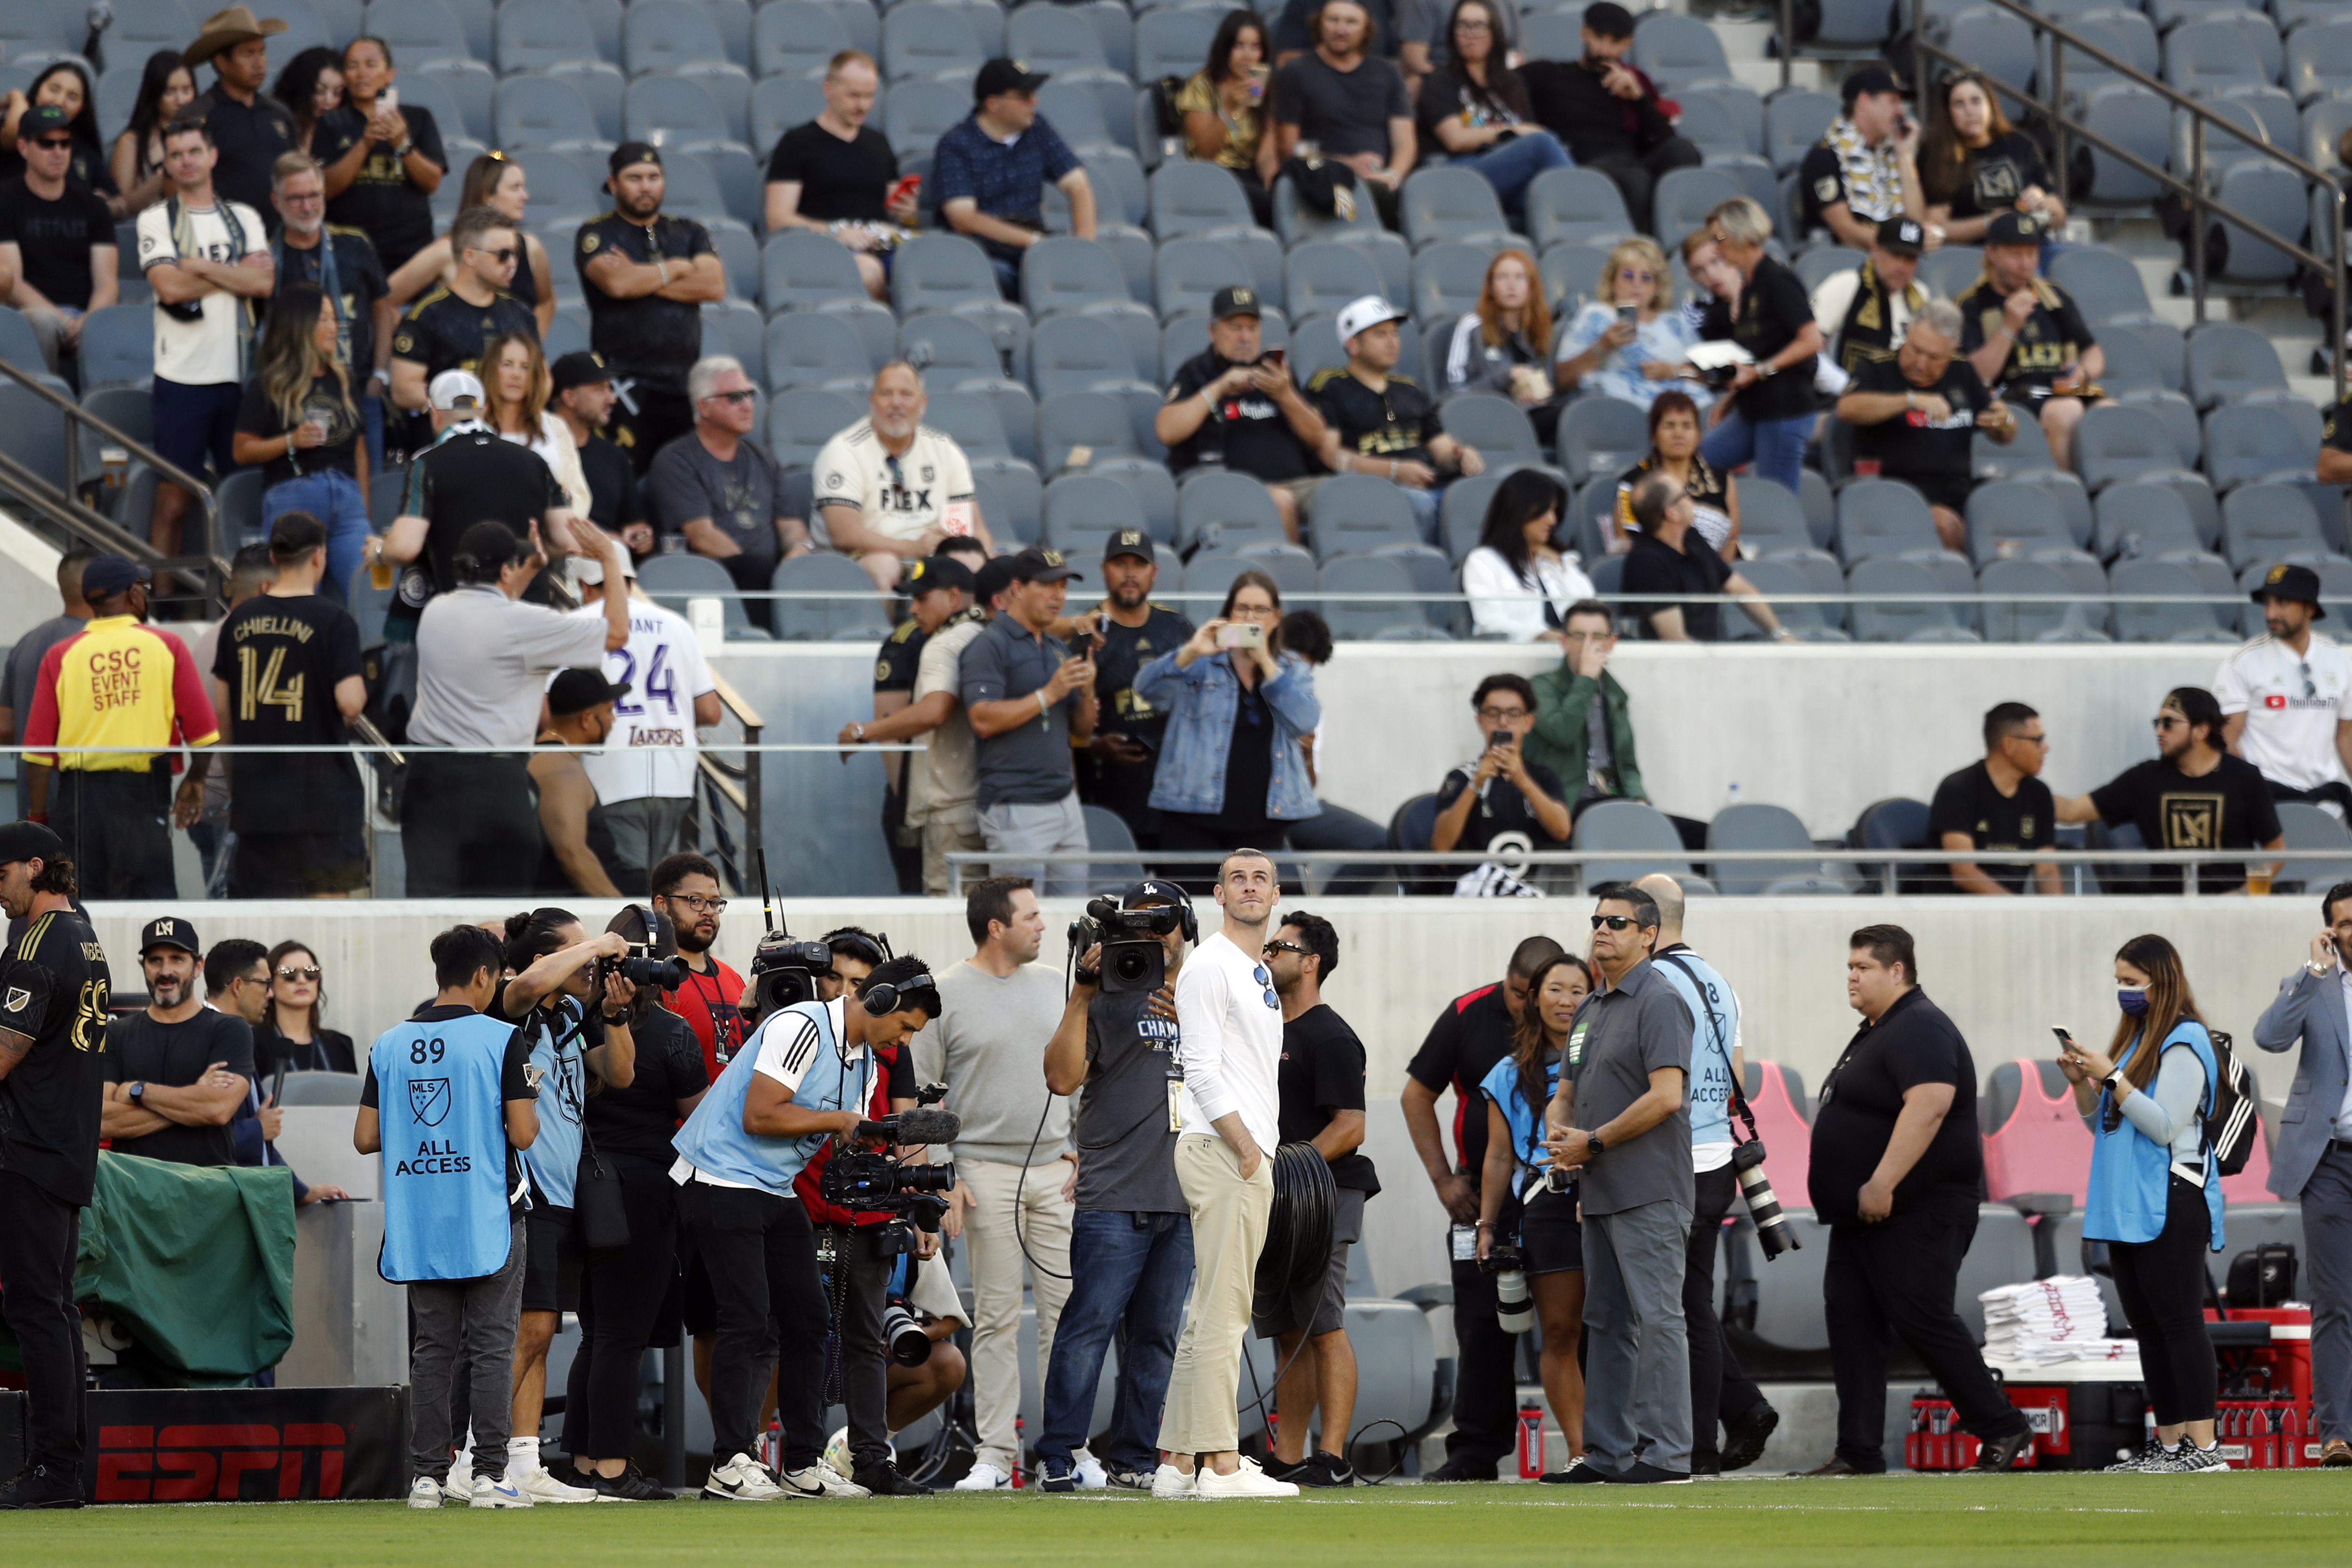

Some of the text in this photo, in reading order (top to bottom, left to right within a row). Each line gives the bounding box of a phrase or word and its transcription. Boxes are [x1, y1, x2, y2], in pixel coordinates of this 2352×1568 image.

[881, 489, 933, 512] FLEX
[233, 615, 314, 644] CHIELLINI
[629, 619, 664, 635] ANT
[89, 647, 141, 674] CSC
[91, 671, 141, 694] EVENT
[237, 645, 305, 722] 14
[608, 644, 678, 717] 24
[94, 690, 141, 711] STAFF
[1113, 689, 1151, 714] FL
[1144, 883, 1158, 895] LA
[1137, 1019, 1180, 1039] CHAM
[410, 1038, 445, 1065] 89
[1703, 1067, 1727, 1082] ALL
[412, 1082, 435, 1094] MLS
[417, 1139, 458, 1156] ALL
[395, 1156, 471, 1177] ACCESS
[94, 1422, 346, 1502] ESPN
